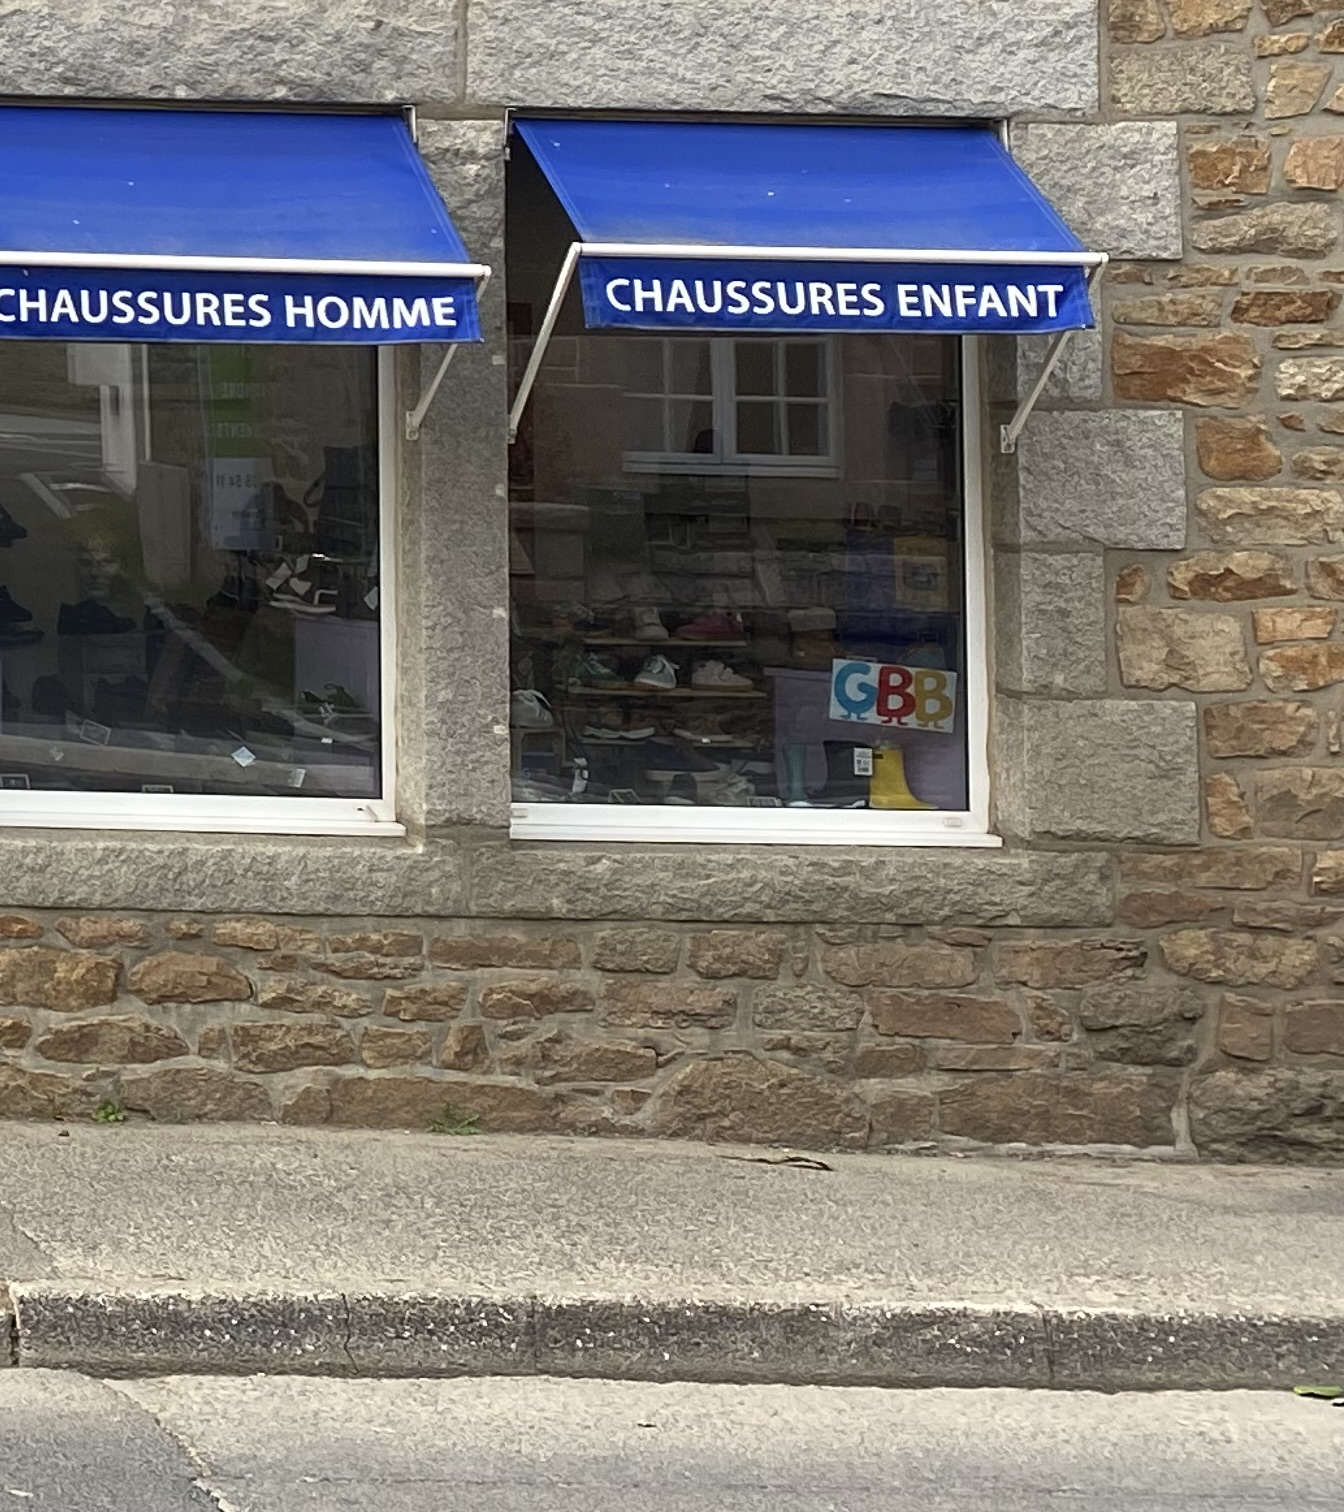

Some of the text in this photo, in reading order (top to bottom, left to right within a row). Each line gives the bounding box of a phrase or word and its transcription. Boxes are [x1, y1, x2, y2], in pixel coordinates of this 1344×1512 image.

[284, 295, 458, 329] HOMME
[606, 278, 1064, 318] CHAUSSURES ENFANT
[834, 662, 953, 729] GBB
